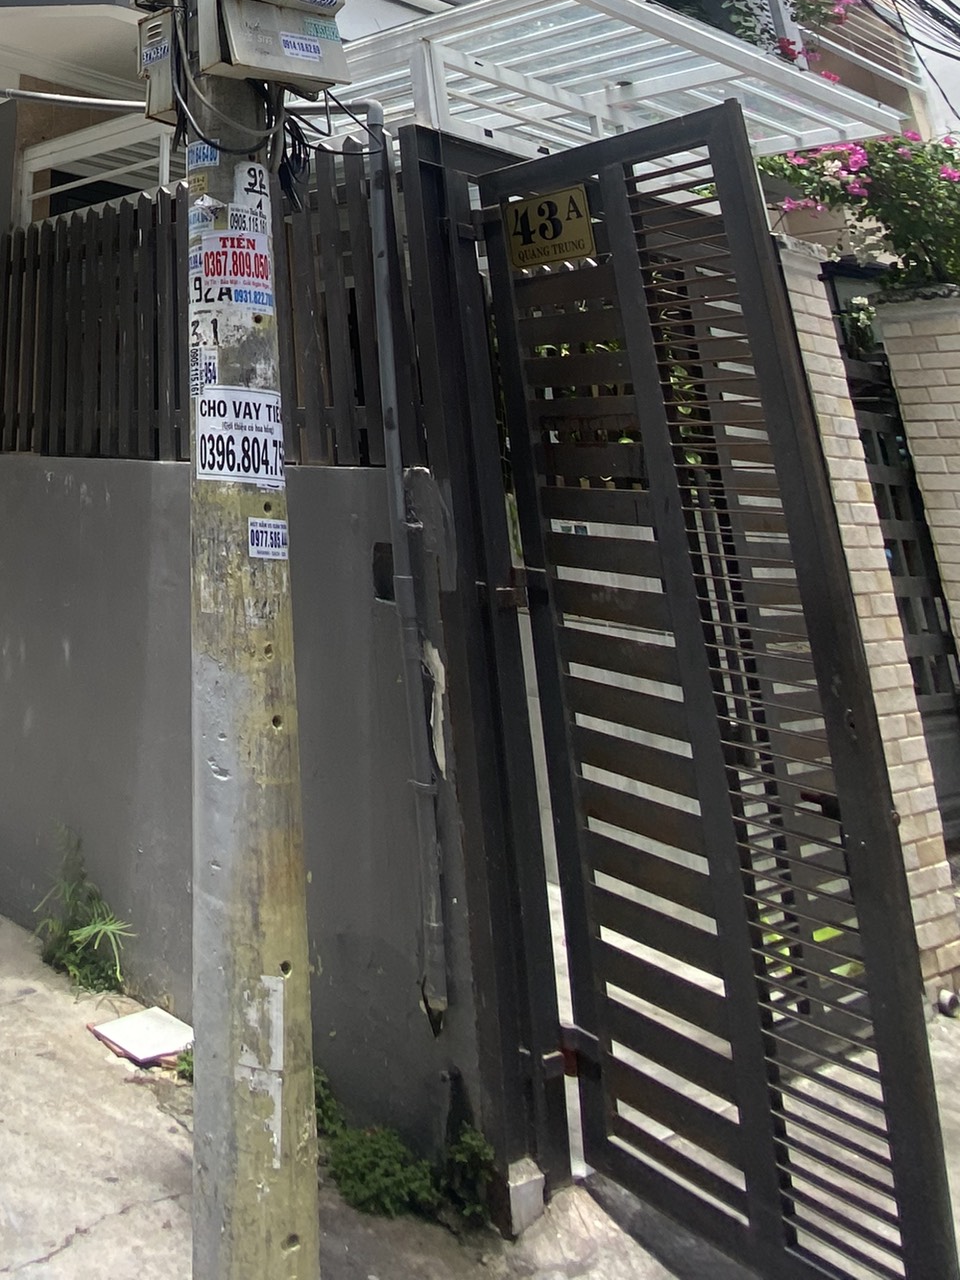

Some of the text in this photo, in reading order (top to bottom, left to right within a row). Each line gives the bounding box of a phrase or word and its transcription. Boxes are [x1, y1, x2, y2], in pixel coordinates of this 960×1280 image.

[518, 239, 586, 262] QUANG TRUNG
[200, 400, 227, 418] CHO
[232, 401, 262, 420] VAY
